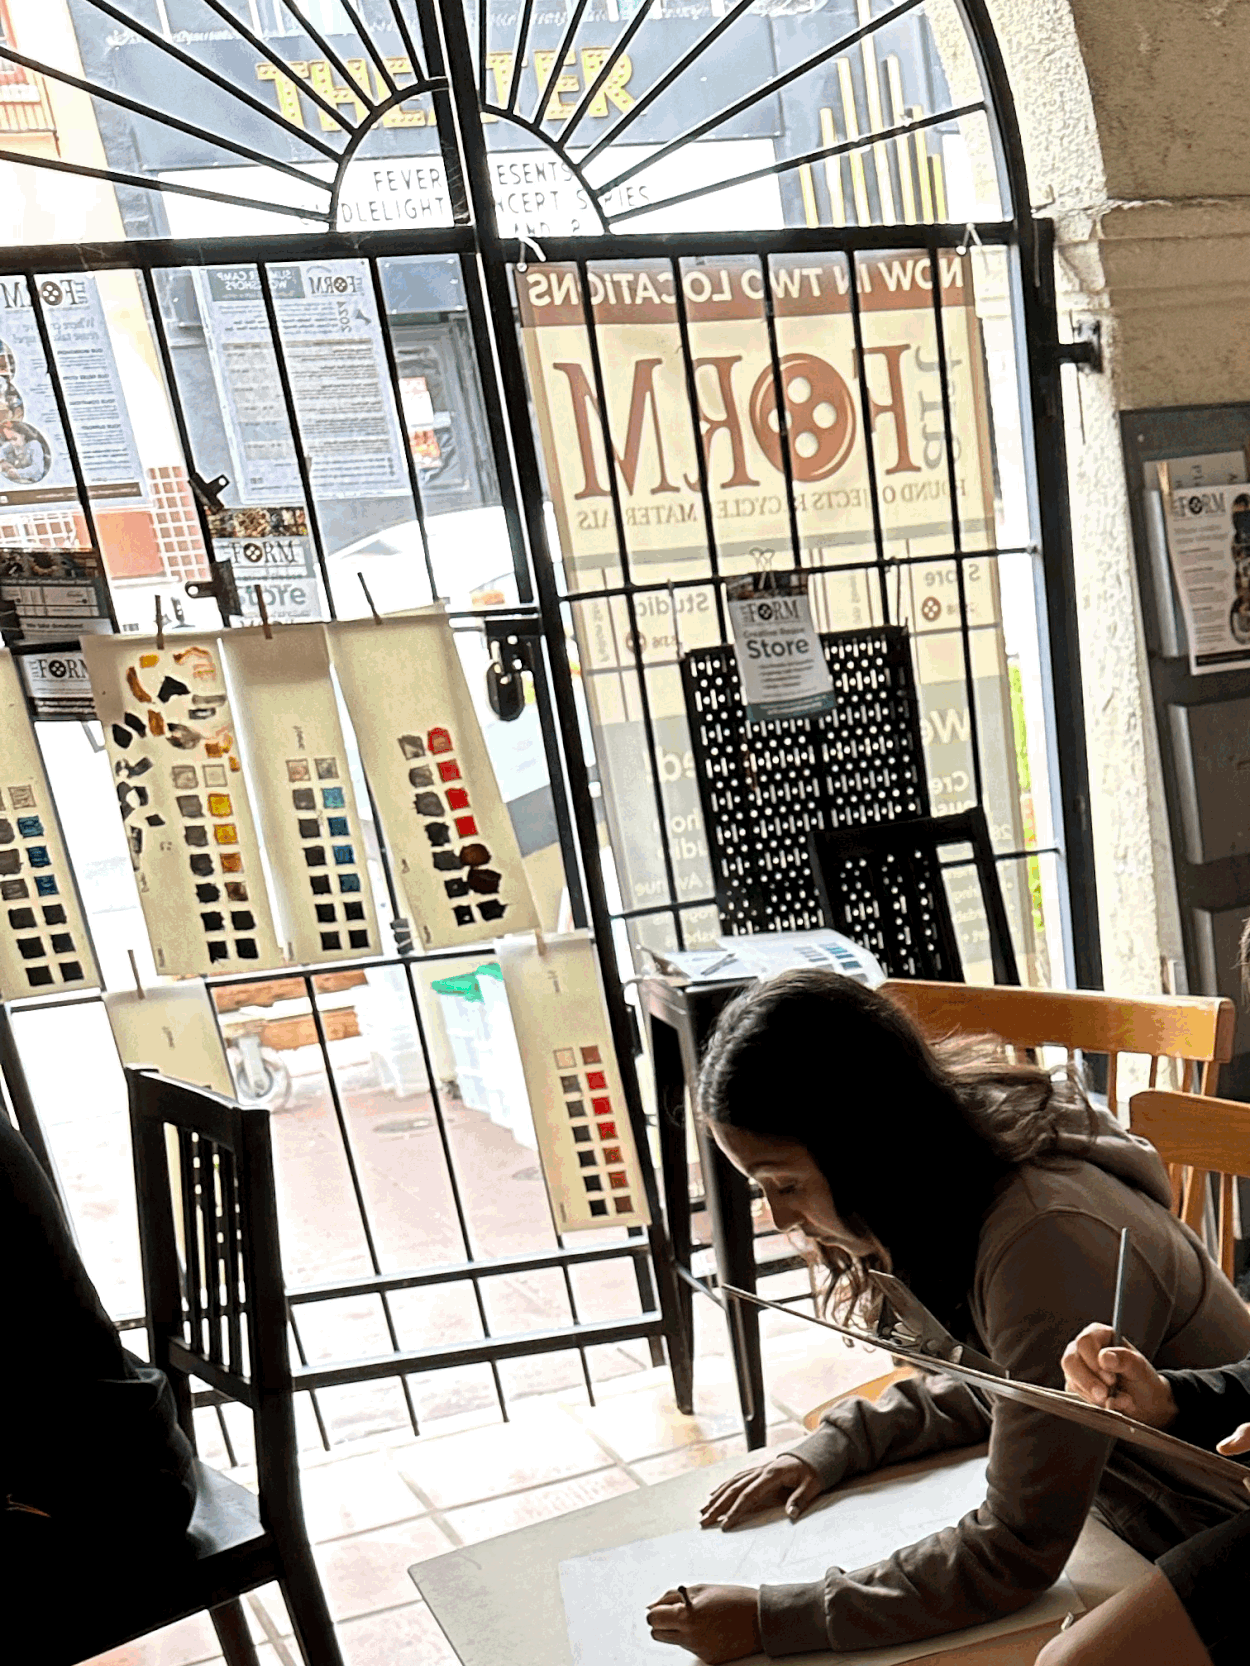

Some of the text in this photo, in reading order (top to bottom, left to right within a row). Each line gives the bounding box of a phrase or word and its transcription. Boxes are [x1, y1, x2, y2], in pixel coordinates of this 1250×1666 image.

[255, 45, 642, 132] THETER
[372, 160, 575, 193] FEVER ESENTS
[746, 637, 810, 661] Store
